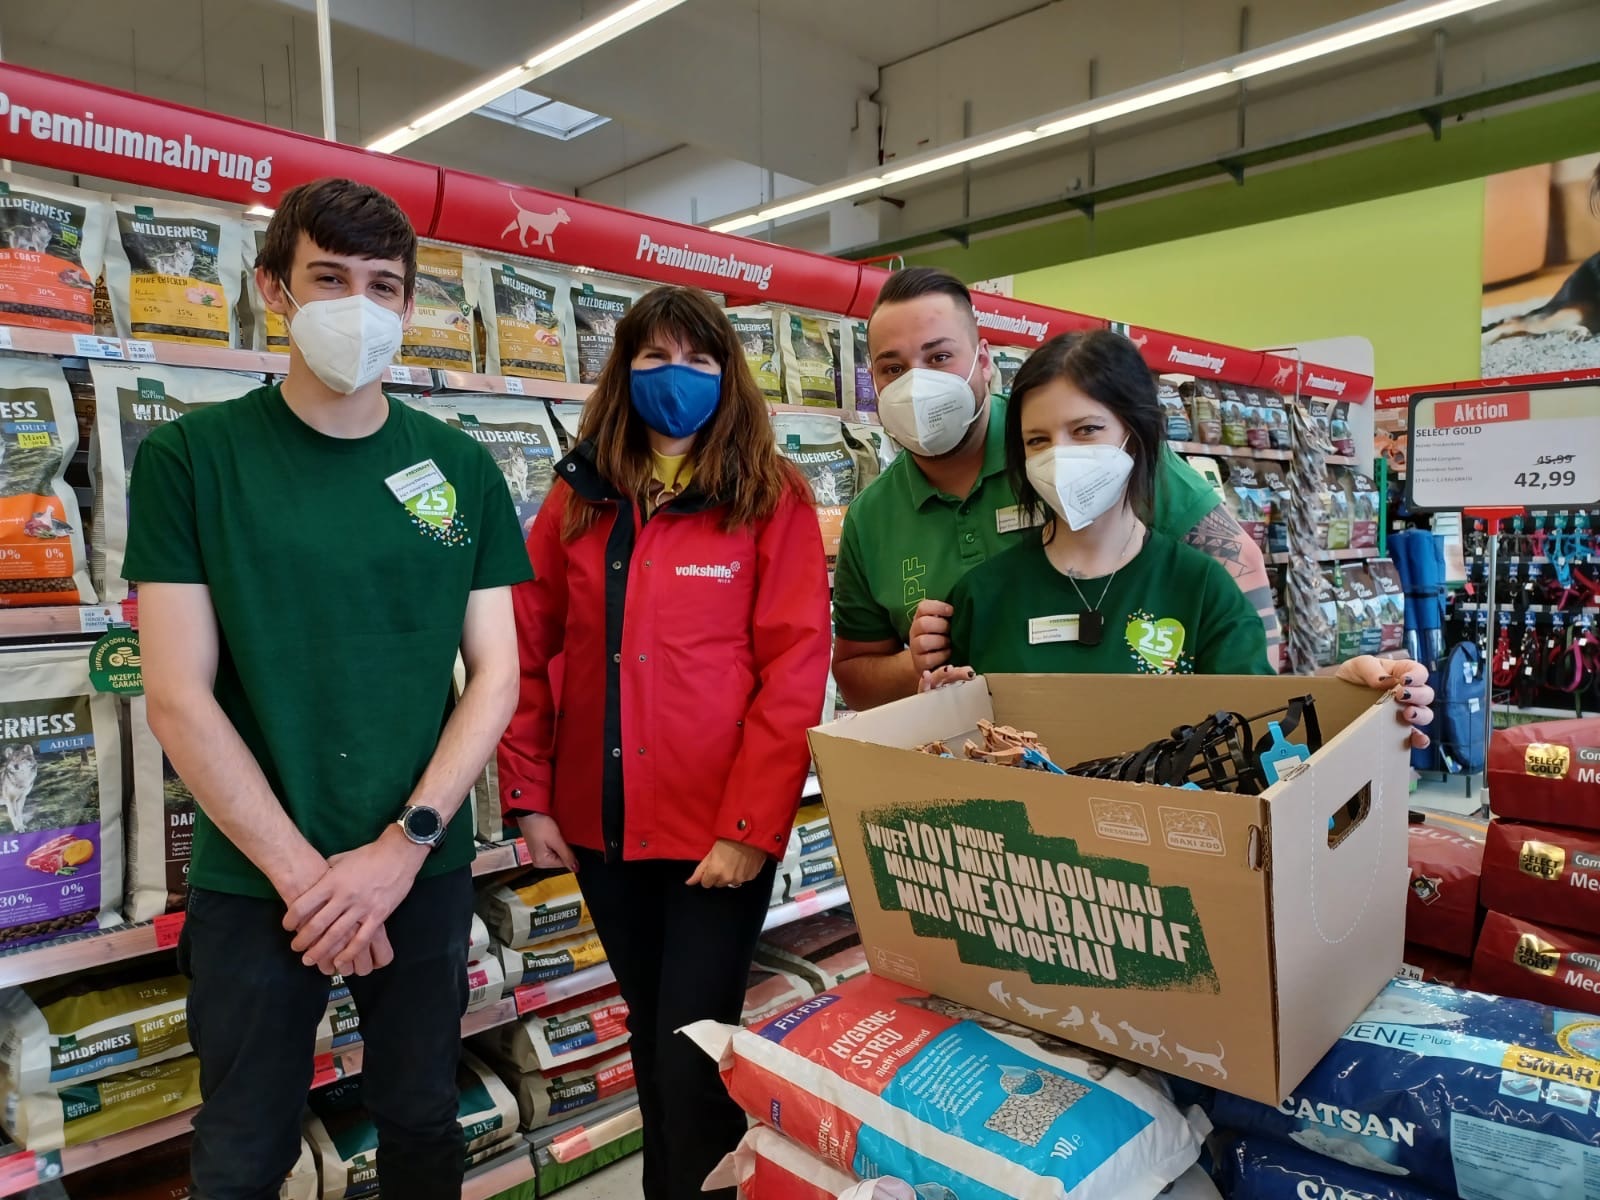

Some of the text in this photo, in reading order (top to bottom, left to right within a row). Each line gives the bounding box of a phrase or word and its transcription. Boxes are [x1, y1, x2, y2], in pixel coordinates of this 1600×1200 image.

[131, 221, 208, 242] WILDERNESS
[636, 233, 773, 291] Premiumnahrung
[501, 275, 548, 301] WILDERNESS
[577, 295, 625, 313] WILDERNESS
[733, 321, 771, 332] ILDERNESS
[1454, 402, 1509, 422] Aktion
[1415, 426, 1482, 438] SELECT GOLD
[1514, 470, 1576, 490] 42,99
[415, 489, 449, 512] 25
[45, 548, 65, 559] 0%
[1139, 622, 1174, 653] 25
[50, 737, 85, 749] ADULT
[1529, 754, 1566, 768] SELECT
[1531, 764, 1562, 775] GOLD
[866, 822, 908, 855] WUFF
[951, 823, 1005, 855] WOUAF
[1169, 836, 1221, 850] MAXI ZOO
[1521, 854, 1560, 869] SELECT
[1525, 863, 1554, 876] GOLD
[61, 883, 84, 896] 0%
[883, 850, 943, 889] MIAUW
[1005, 852, 1096, 902] MIAOU
[1095, 876, 1164, 918] MIAU
[534, 907, 578, 927] WILDERNESS
[896, 879, 951, 922] MIAO
[954, 910, 986, 937] VAU
[1518, 945, 1554, 963] SELECT
[1519, 954, 1550, 970] GOLD
[139, 987, 168, 999] 12 kg
[140, 1018, 165, 1034] TRUE
[548, 1020, 590, 1041] WILDERNESS
[828, 1009, 898, 1060] HYGIENE-
[58, 1033, 131, 1064] WILDERNESS
[851, 1028, 904, 1070] STREU
[875, 1029, 931, 1078] nicht klumpend
[75, 1056, 114, 1076] JUNIOR
[104, 1082, 157, 1106] WILDERNESS
[551, 1081, 596, 1100] WILDERNESS
[472, 1123, 482, 1135] 12
[1277, 1095, 1416, 1147] CATSAN
